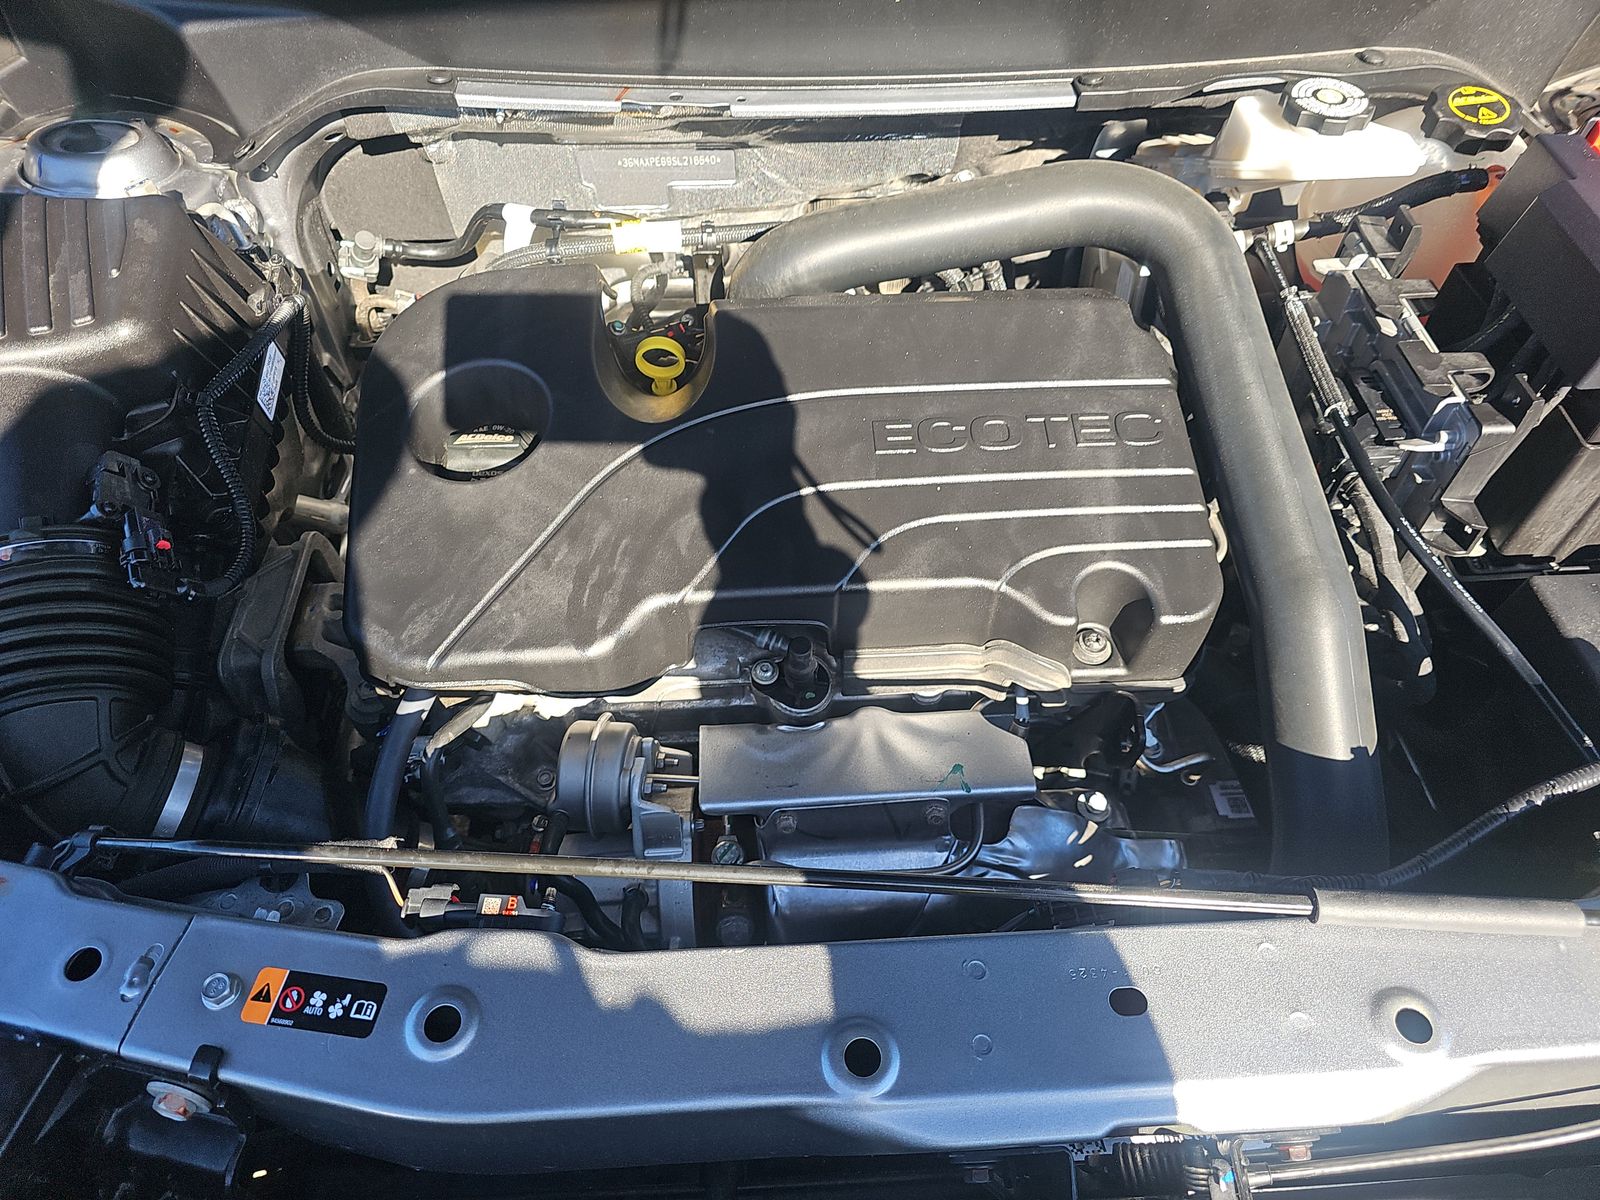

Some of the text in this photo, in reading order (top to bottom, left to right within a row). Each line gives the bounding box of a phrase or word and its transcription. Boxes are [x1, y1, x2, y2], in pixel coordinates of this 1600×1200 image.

[457, 433, 514, 442] ACDelco
[870, 410, 1164, 455] ECOTEC
[507, 896, 518, 910] B
[303, 1005, 323, 1016] AUTO
